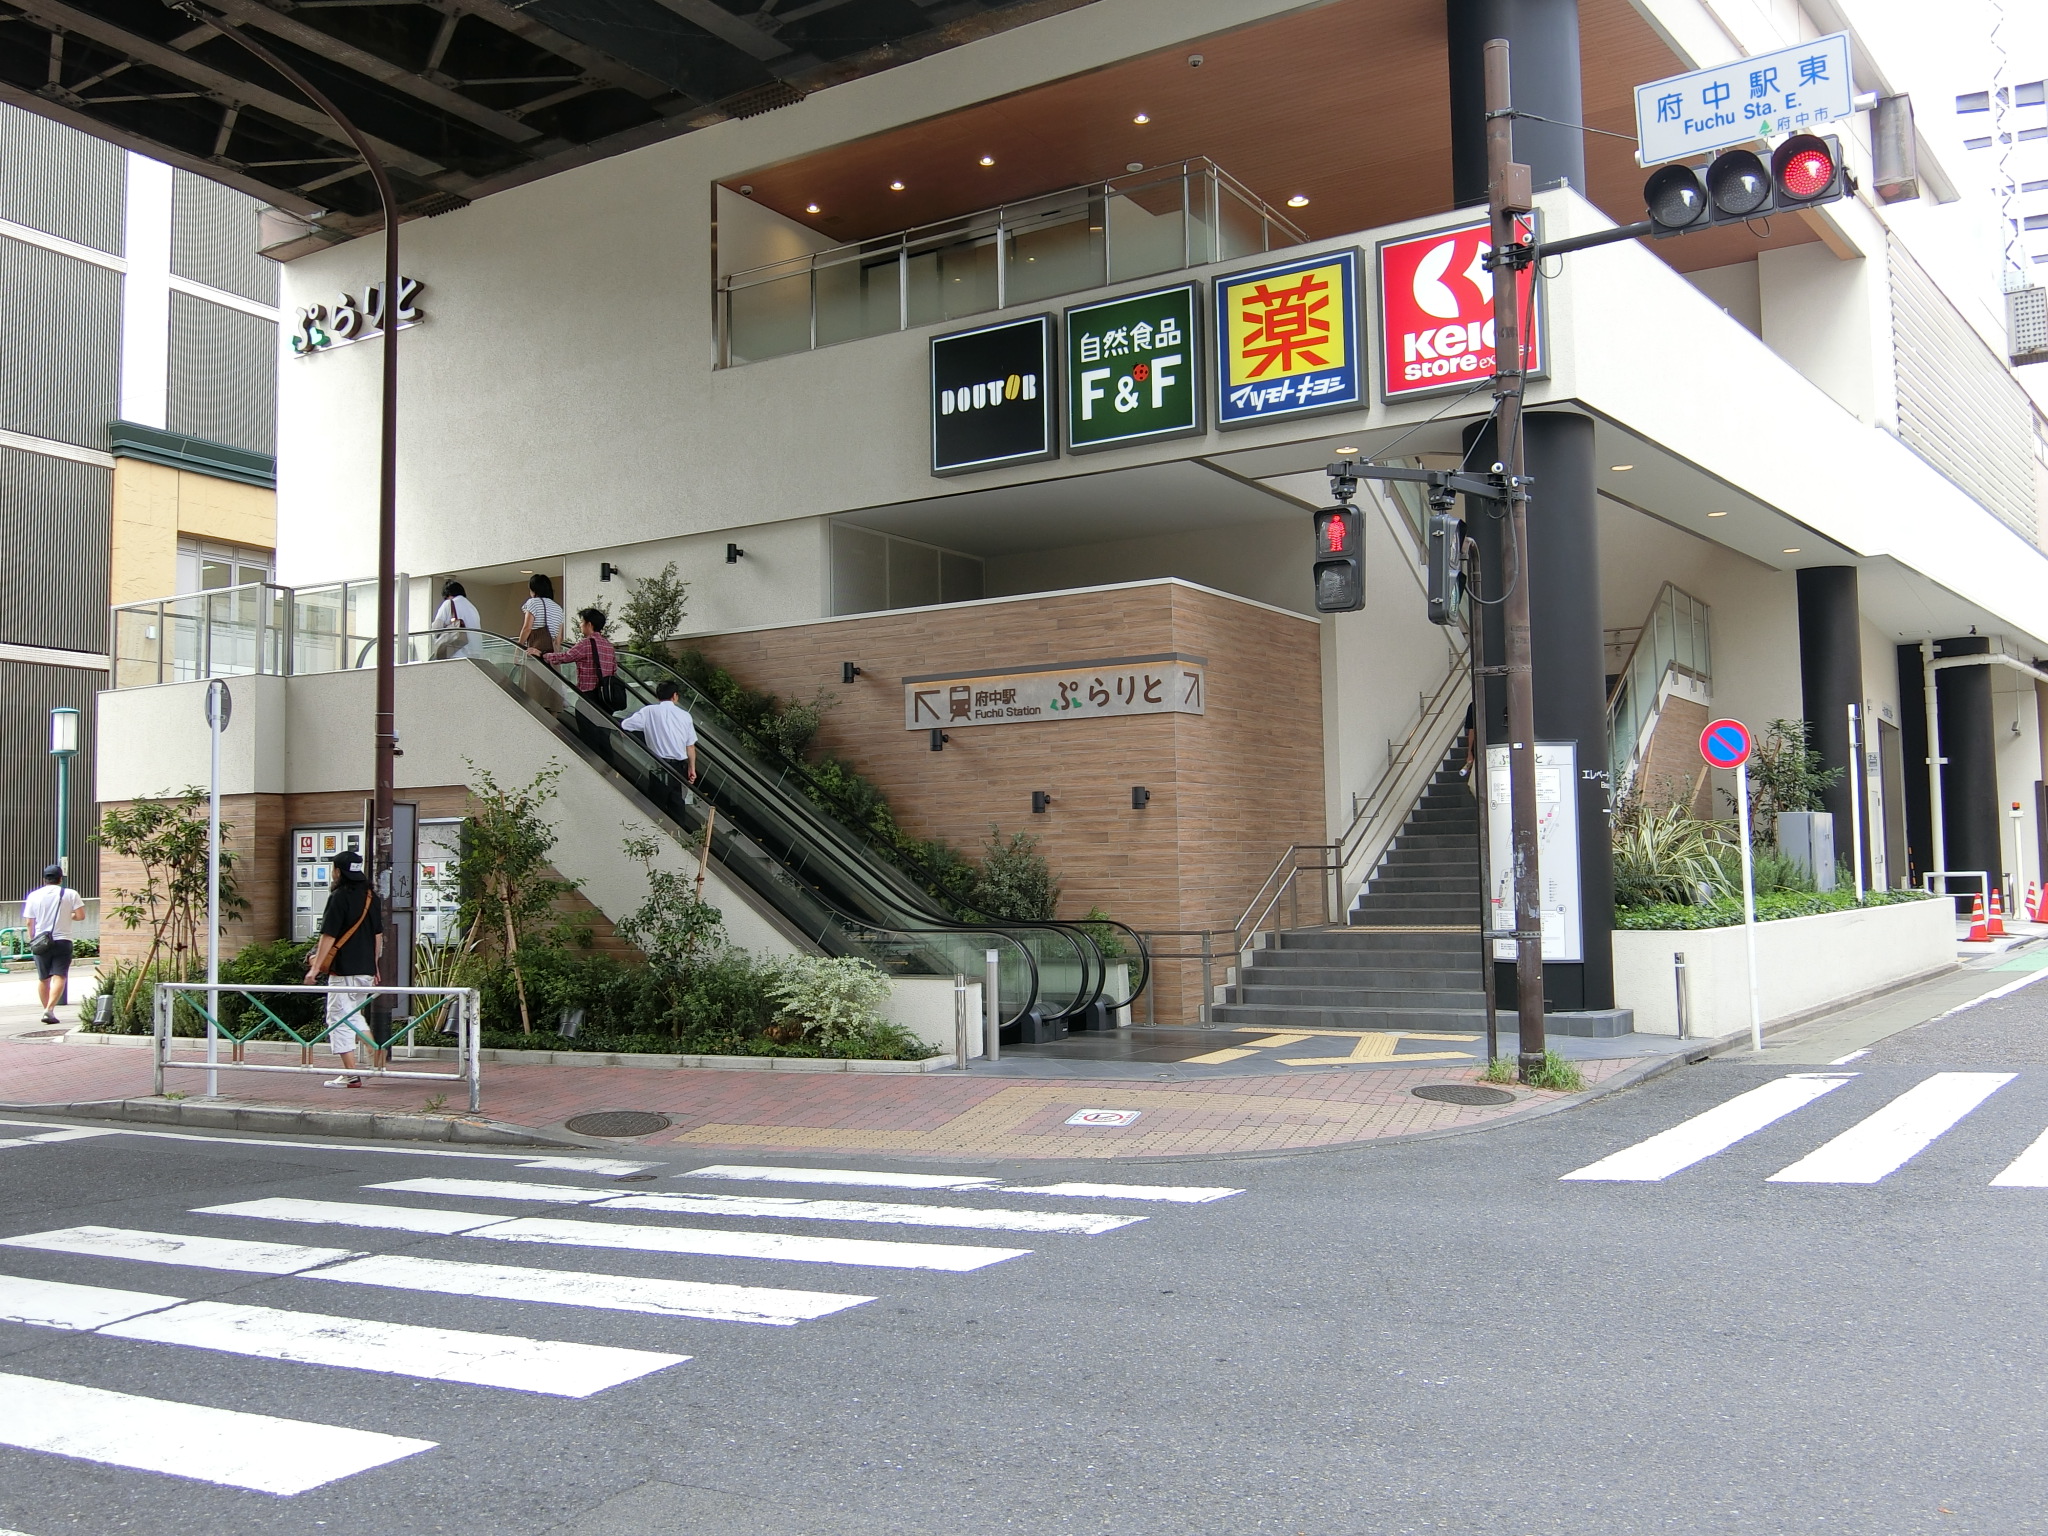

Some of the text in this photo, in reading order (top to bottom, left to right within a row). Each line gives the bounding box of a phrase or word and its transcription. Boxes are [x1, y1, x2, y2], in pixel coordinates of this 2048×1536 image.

[1656, 54, 1830, 124] 府中駅東
[1684, 92, 1802, 135] Fuchu Sta. E.
[1777, 106, 1829, 131] 府中市
[1080, 317, 1182, 363] 自然食品
[1241, 273, 1331, 379] 薬
[1404, 354, 1478, 381] store
[941, 374, 1037, 416] DOUTOR
[975, 688, 1017, 707] 府中駅
[1006, 705, 1041, 717] Station
[1050, 674, 1163, 711] ぷらりと
